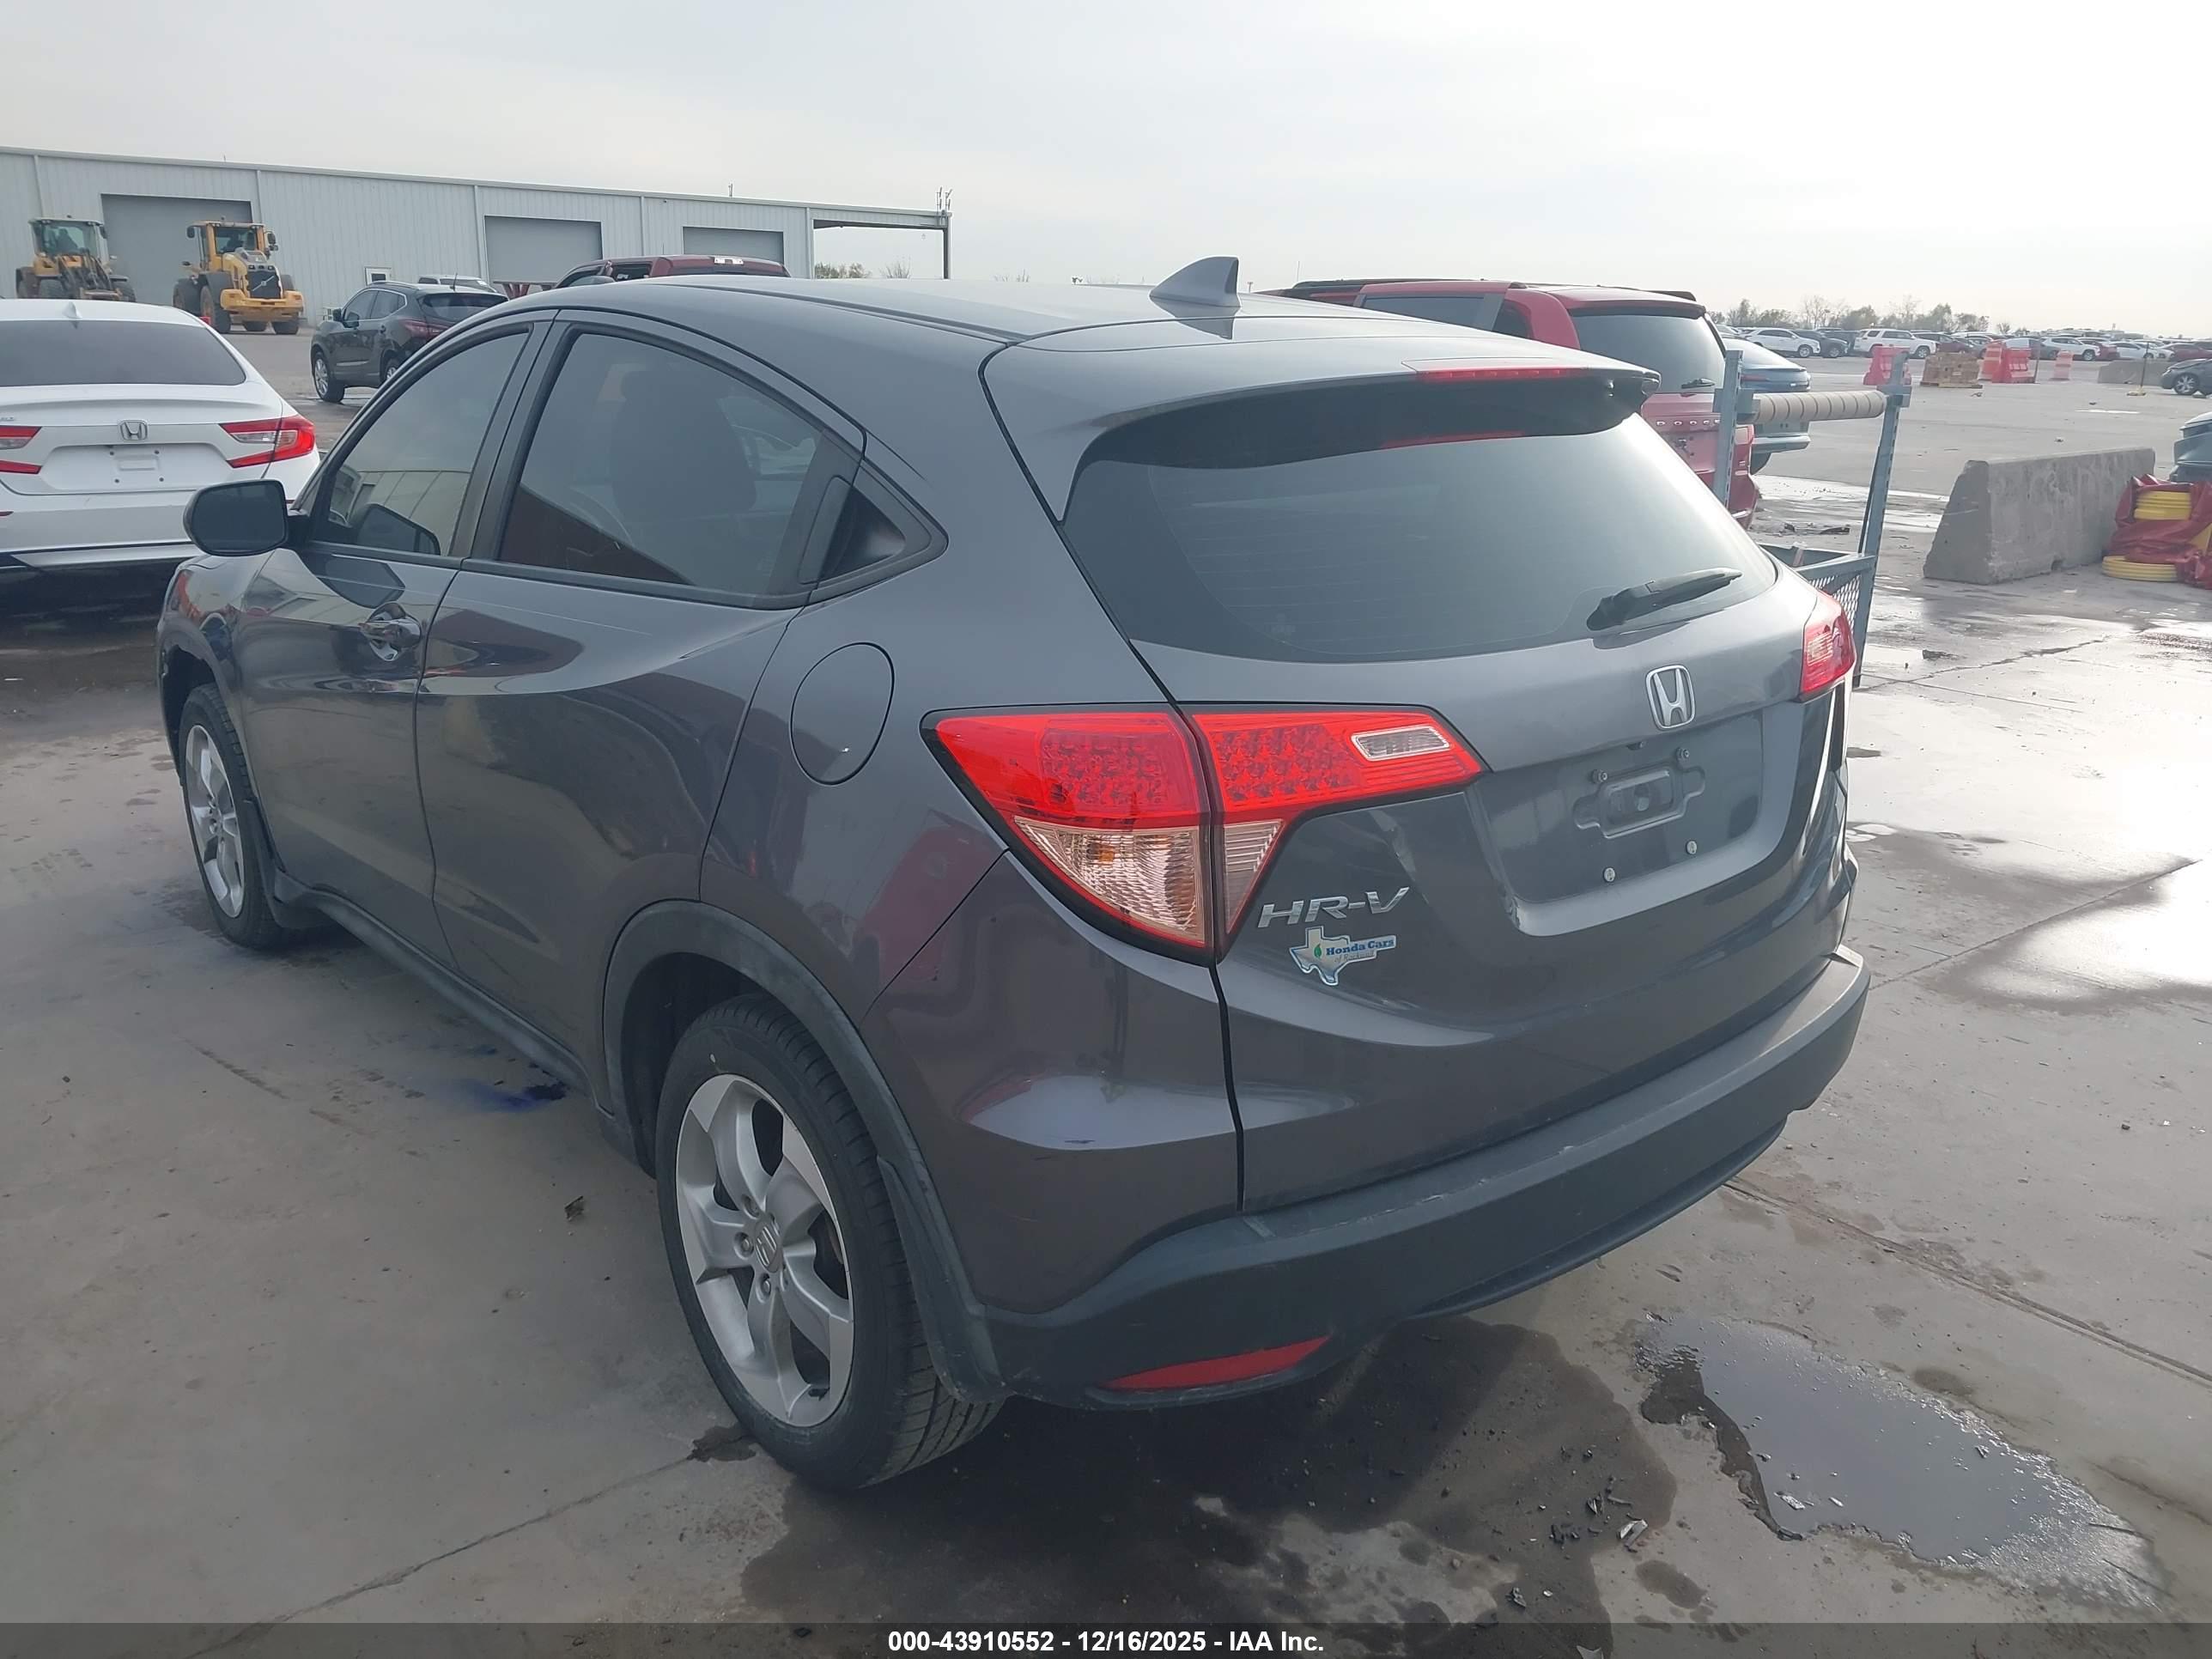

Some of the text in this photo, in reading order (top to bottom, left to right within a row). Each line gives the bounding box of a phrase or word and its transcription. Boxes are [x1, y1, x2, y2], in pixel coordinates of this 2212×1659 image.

[1258, 887, 1410, 928] HR-V
[1326, 939, 1395, 956] Honda Cars
